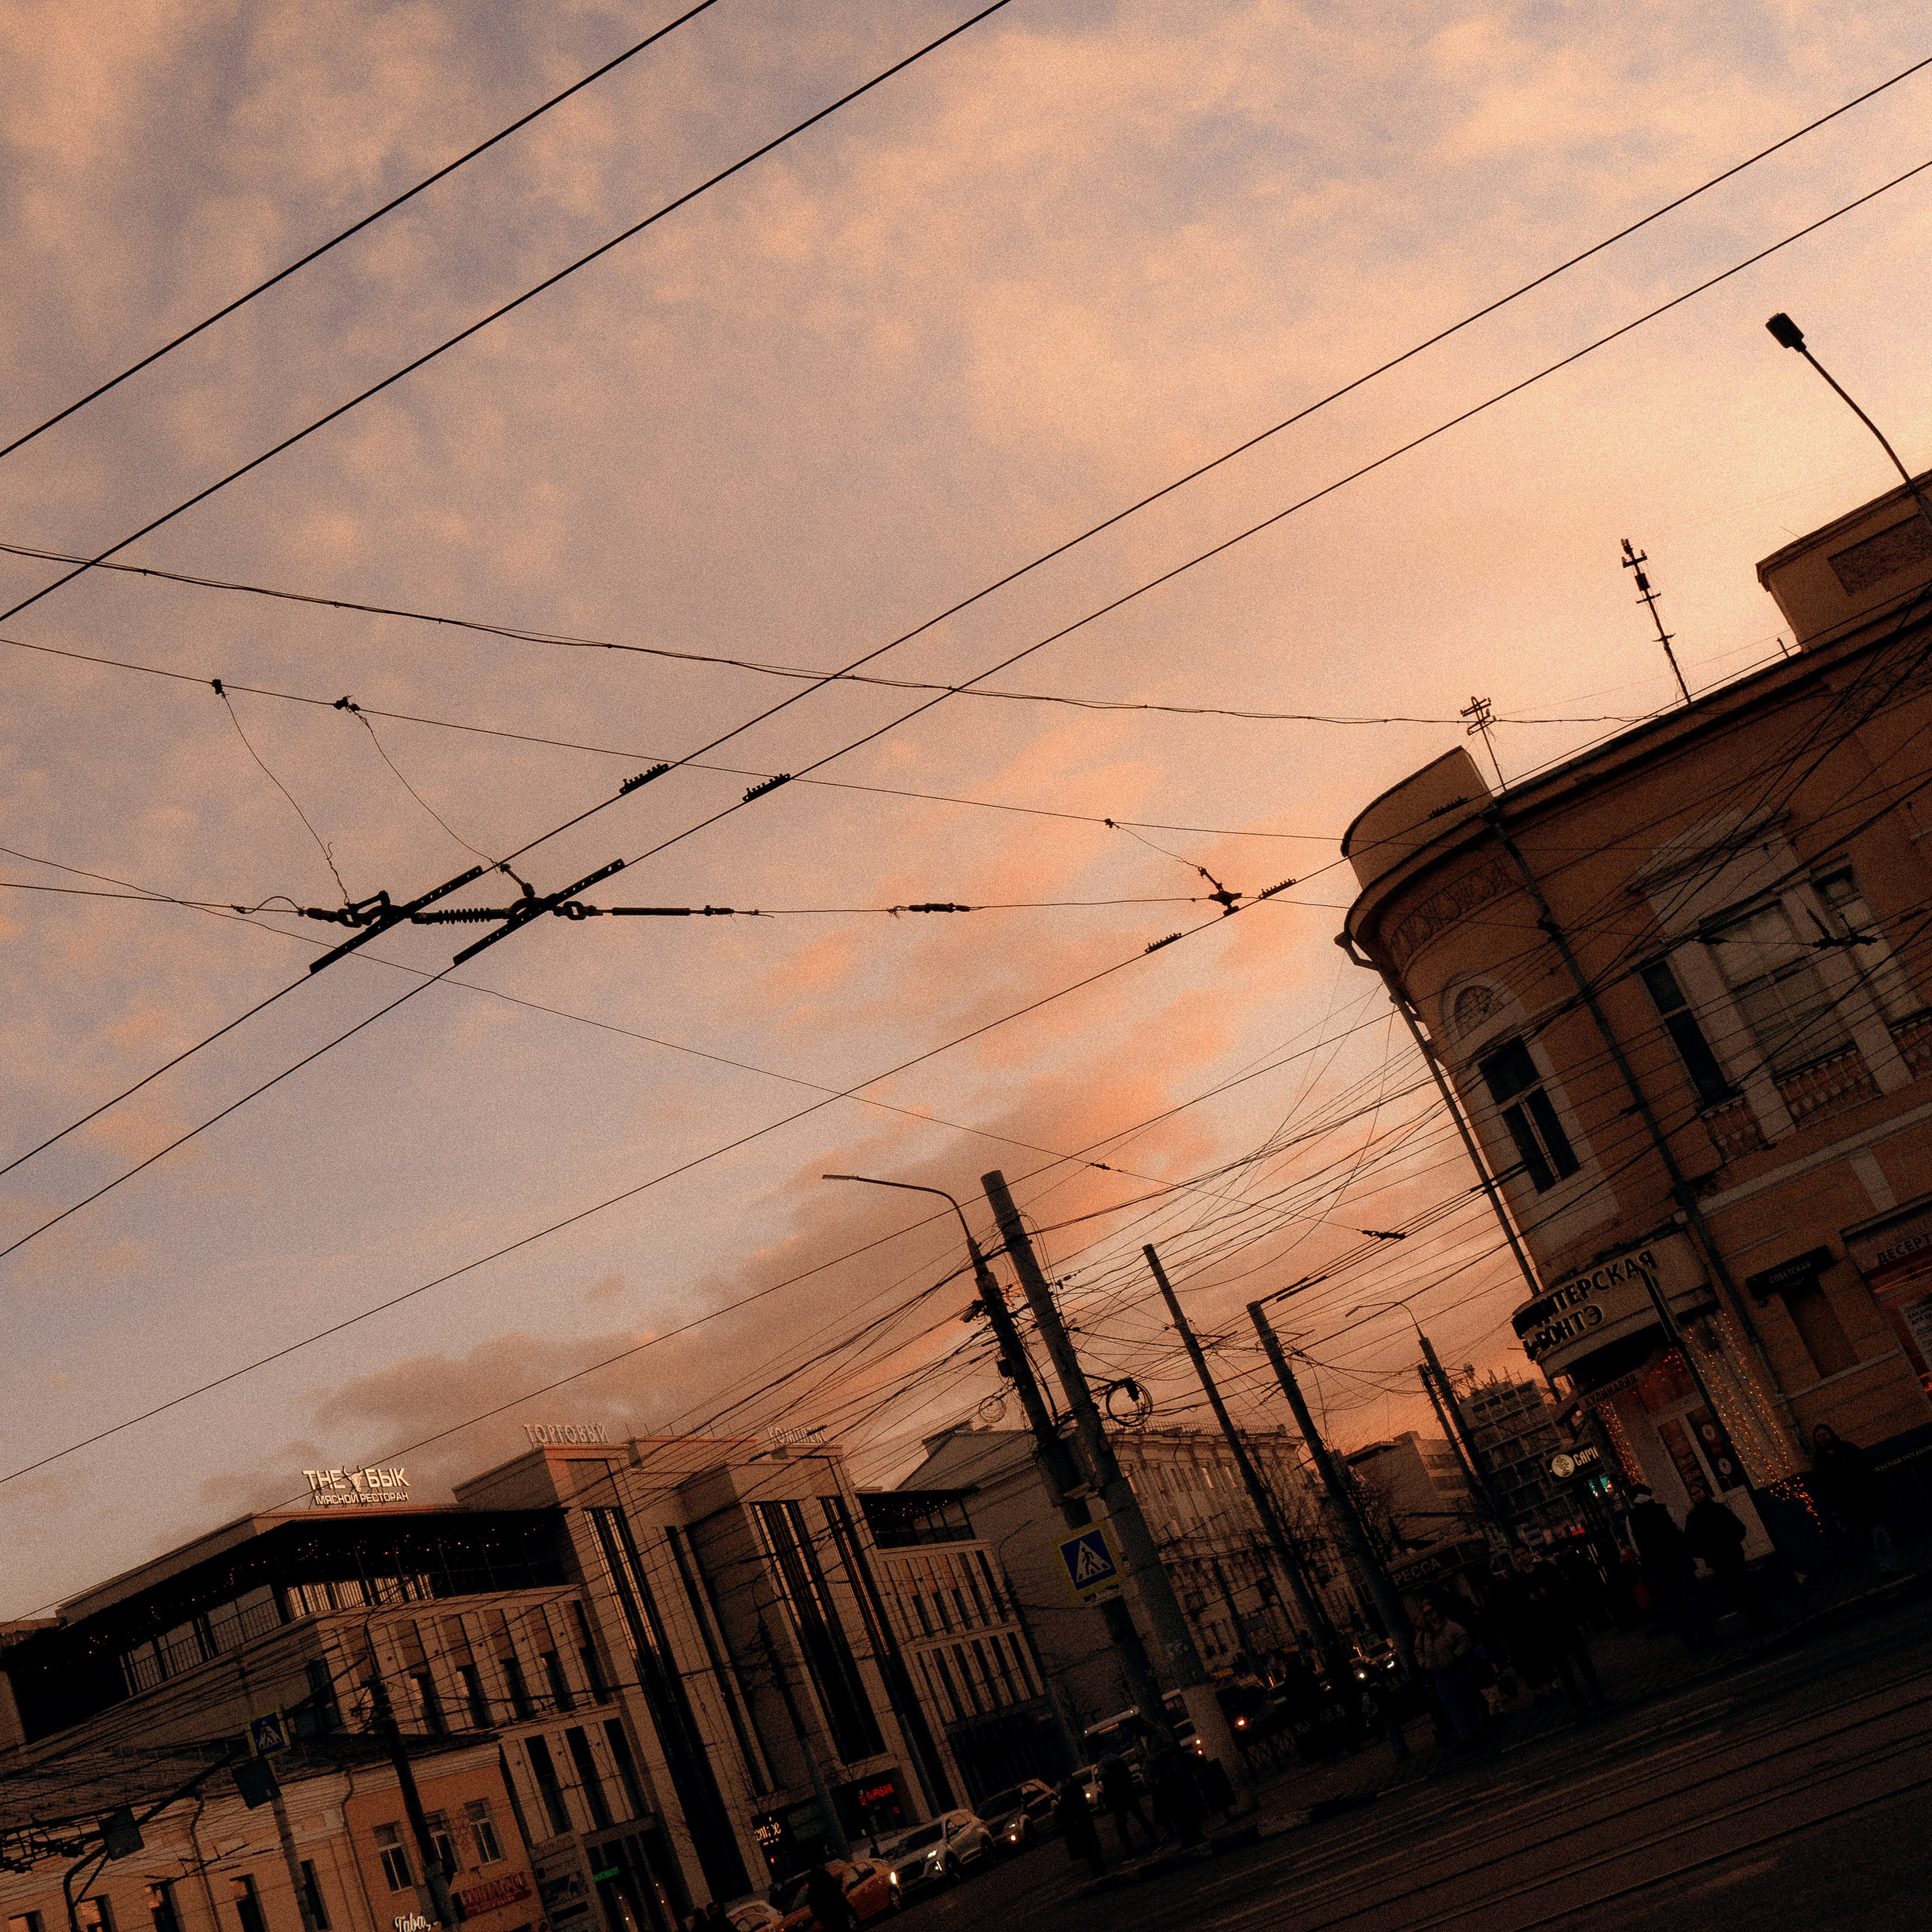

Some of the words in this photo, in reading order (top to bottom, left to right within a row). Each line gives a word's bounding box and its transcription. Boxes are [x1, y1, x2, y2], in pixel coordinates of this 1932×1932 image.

[1769, 1261, 1812, 1284] СОВЕТСКАЯ
[1585, 1374, 1637, 1407] КУЛИНАРИЯ
[522, 1422, 610, 1444] ТОРГОВЫЙ
[302, 1469, 346, 1490] THE
[365, 1467, 411, 1488] БЫК
[315, 1491, 358, 1506] МЯСНОЙ
[358, 1491, 409, 1504] РЕСТОРАН
[1392, 1557, 1441, 1587] РЕССА
